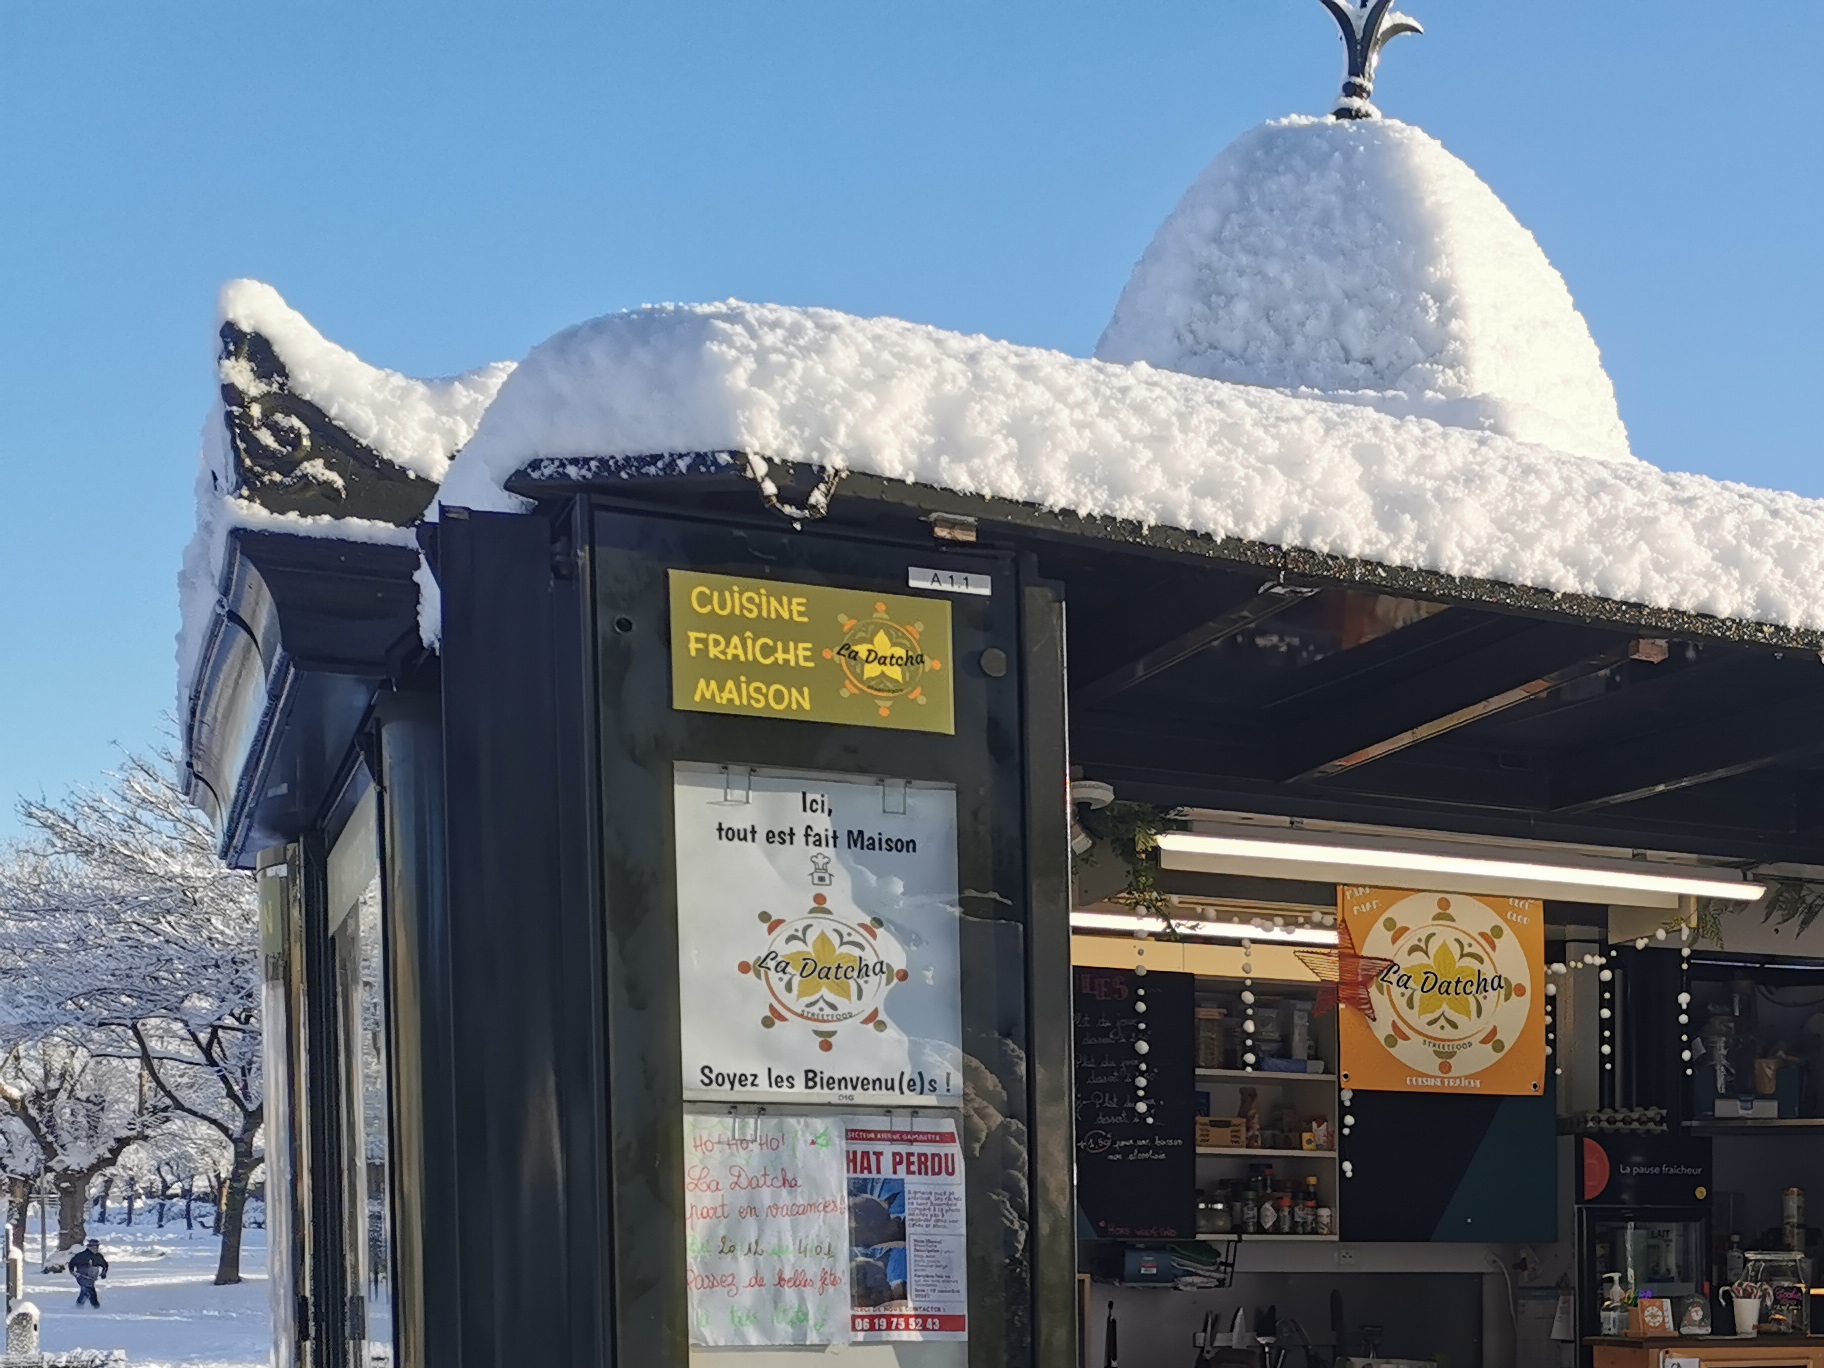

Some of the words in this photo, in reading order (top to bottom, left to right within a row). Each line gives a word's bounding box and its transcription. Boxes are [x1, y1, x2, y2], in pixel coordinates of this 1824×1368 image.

[930, 573, 942, 587] A
[949, 576, 971, 590] 1.1
[686, 630, 816, 668] FRAÎCHE
[835, 642, 858, 662] La
[864, 649, 926, 667] Datcha
[801, 791, 833, 817] Ici,
[716, 821, 758, 844] tout
[765, 825, 796, 846] est
[803, 825, 839, 848] fait
[846, 829, 918, 854] Maison
[757, 949, 789, 976] La
[799, 955, 888, 982] Datcha
[1380, 963, 1410, 990] La
[1420, 968, 1505, 996] Datcha
[699, 1064, 760, 1092] Soyez
[767, 1066, 796, 1090] les
[803, 1067, 938, 1096] Bienvenu(e)s
[728, 1163, 802, 1190] Datcha
[891, 1151, 956, 1177] PERDU
[1620, 1163, 1631, 1174] La
[1632, 1165, 1661, 1176] pause
[738, 1202, 760, 1221] en
[773, 1267, 815, 1289] belles
[854, 1318, 870, 1331] 06
[873, 1318, 887, 1330] 19
[890, 1317, 906, 1330] 75
[908, 1317, 923, 1330] 52
[926, 1317, 940, 1330] 43
